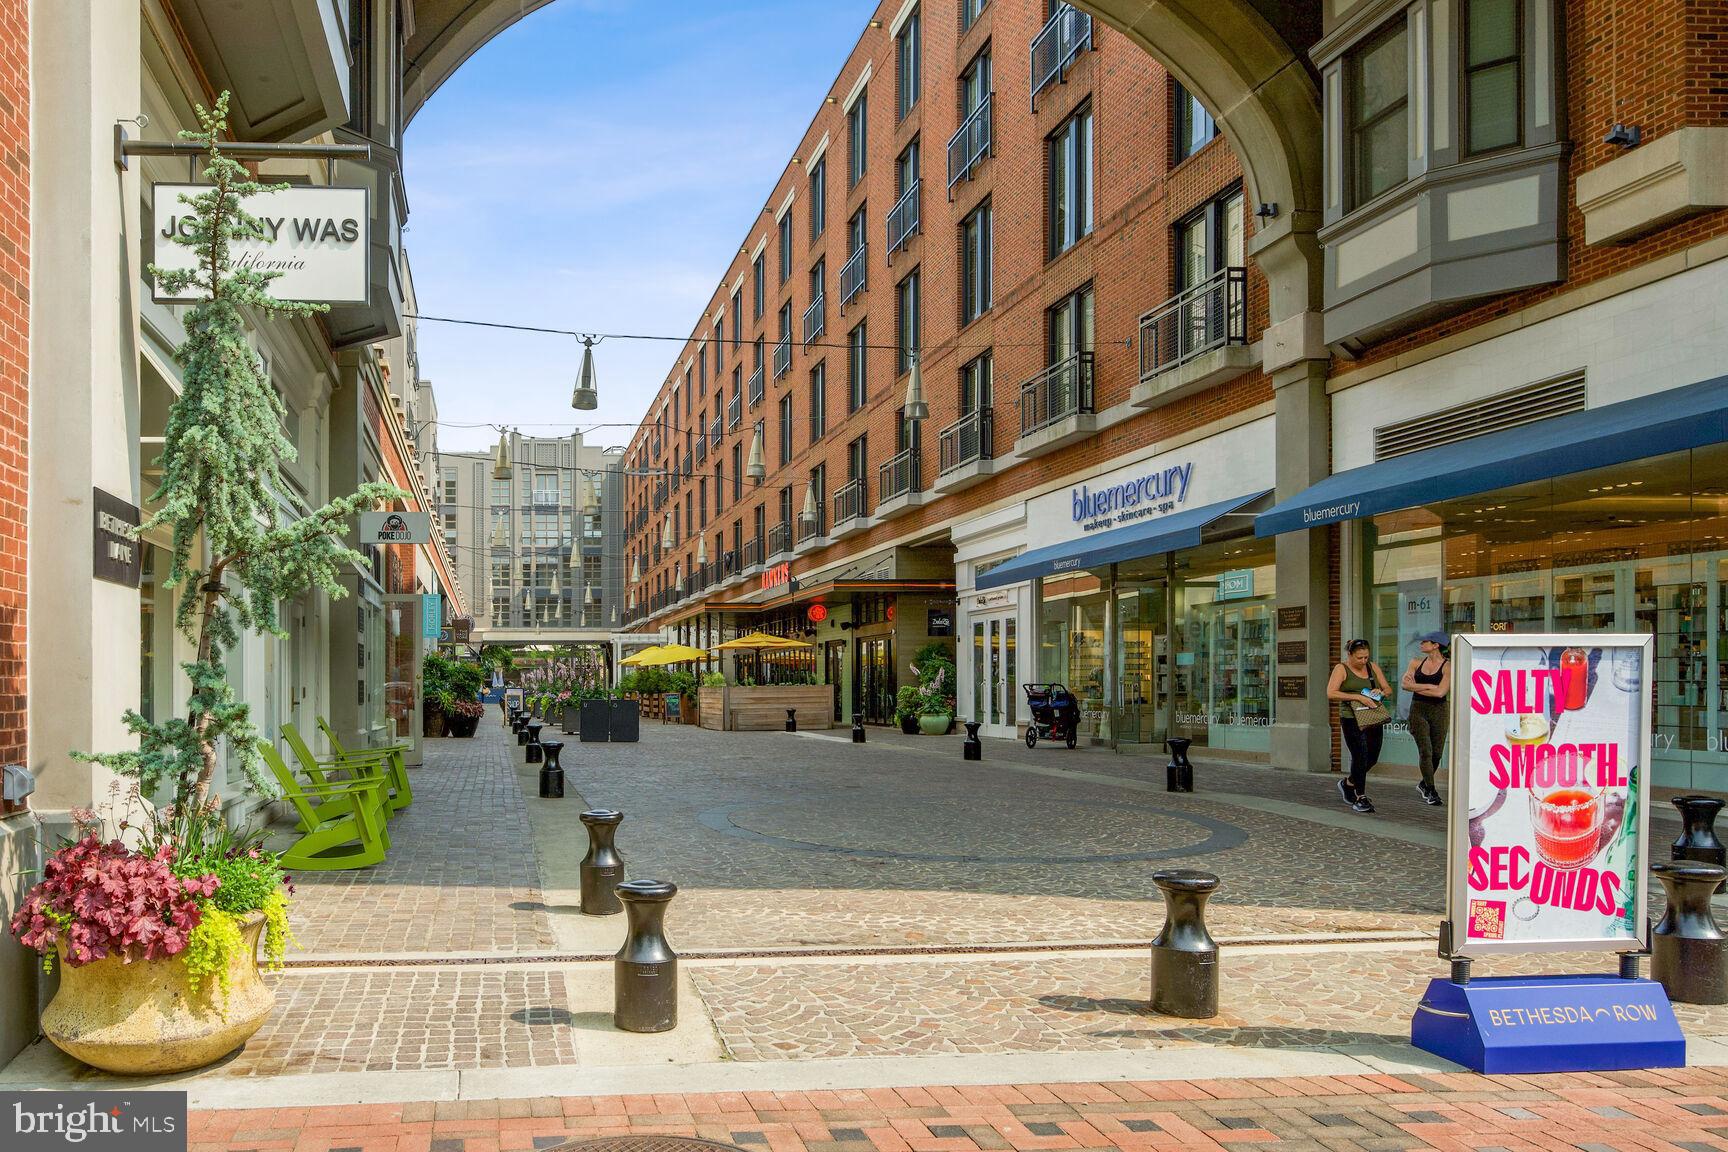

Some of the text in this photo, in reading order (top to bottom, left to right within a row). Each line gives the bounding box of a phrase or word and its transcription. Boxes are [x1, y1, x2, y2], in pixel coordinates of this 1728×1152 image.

[293, 217, 359, 242] WAS
[230, 250, 305, 271] lifornia
[1072, 462, 1192, 522] bluemercury
[1084, 500, 1175, 531] makeup skincare spa
[1303, 501, 1360, 523] bluemercury
[1052, 558, 1082, 570] bluemercury
[1470, 669, 1572, 715] SALTY
[1176, 711, 1219, 727] bluemercury
[1489, 743, 1628, 789] SMOOTH.
[1467, 845, 1626, 918] SECONDS.
[1489, 1004, 1658, 1027] BETHESDA ROW
